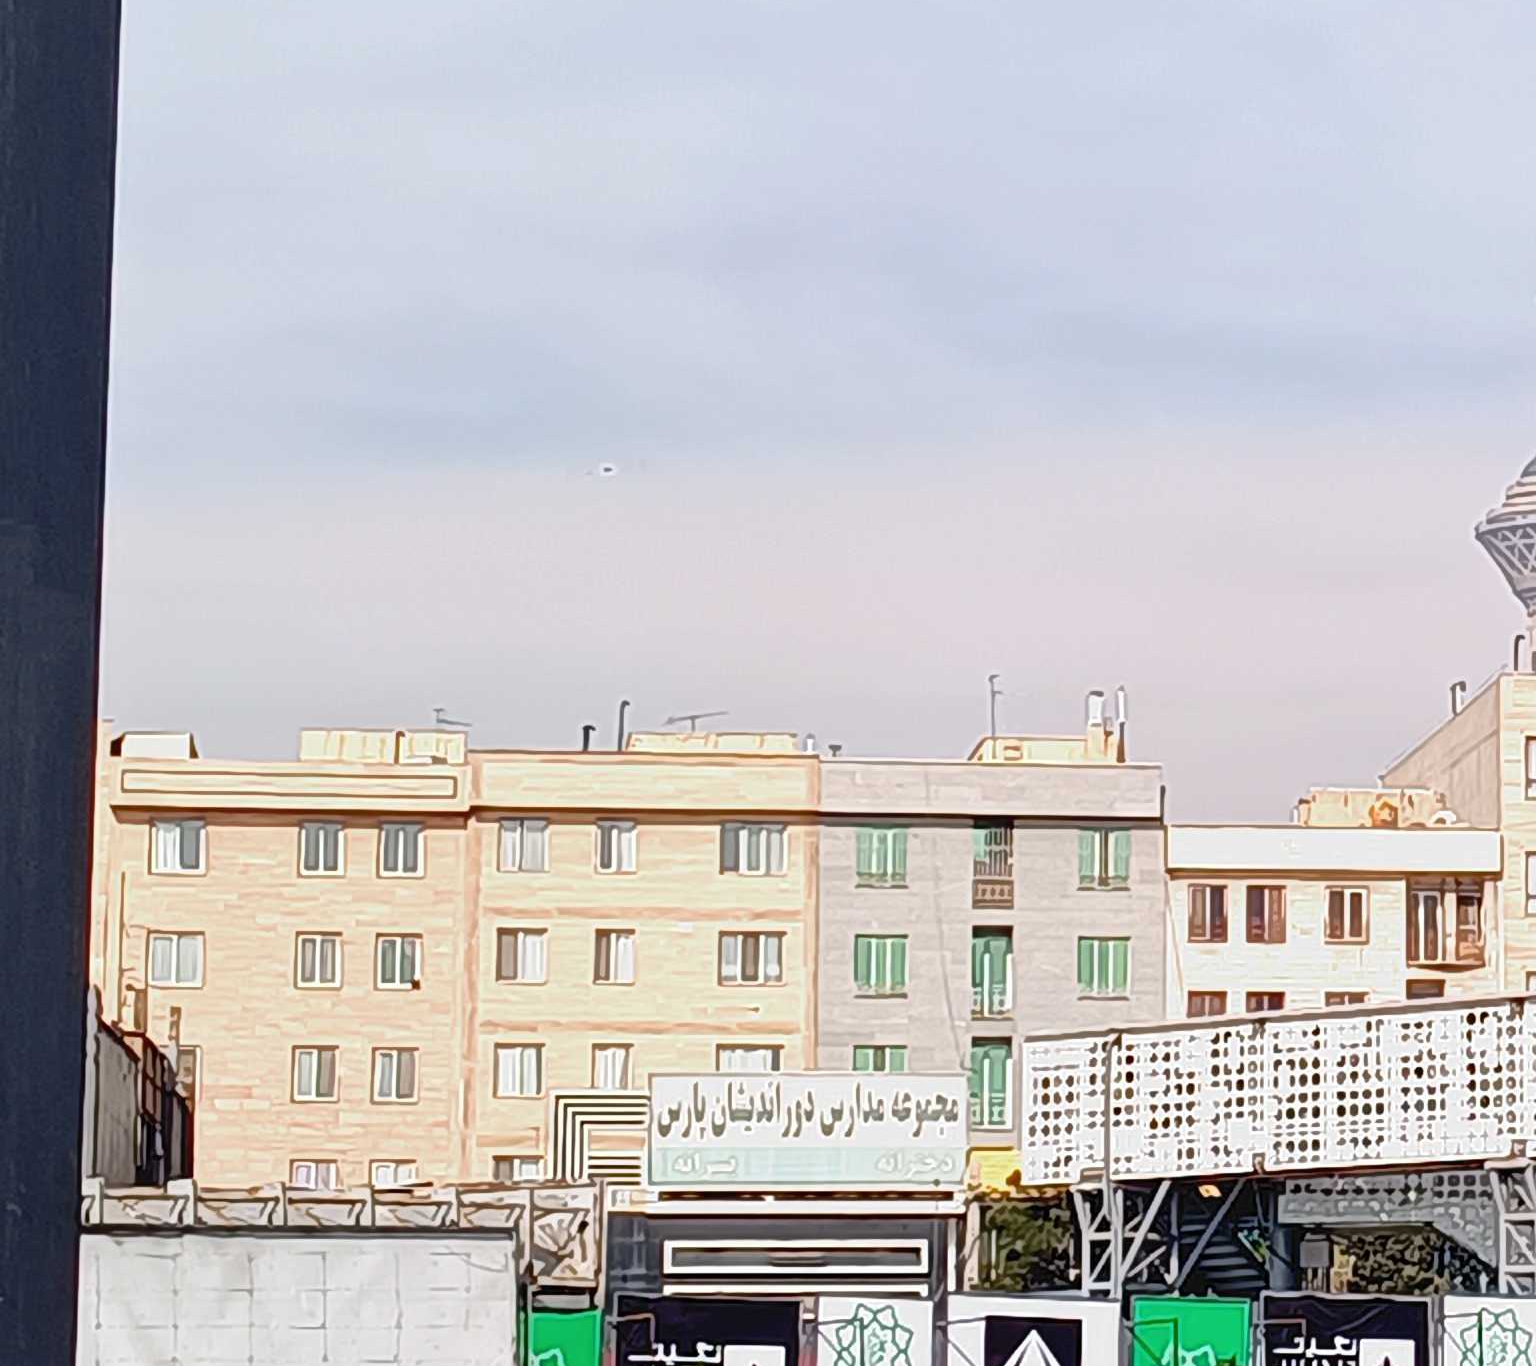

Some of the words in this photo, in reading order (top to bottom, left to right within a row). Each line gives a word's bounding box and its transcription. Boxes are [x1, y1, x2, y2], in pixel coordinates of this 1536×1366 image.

[656, 1081, 706, 1140] پارس
[820, 1082, 885, 1138] مدارس
[891, 1090, 959, 1138] مجموعه
